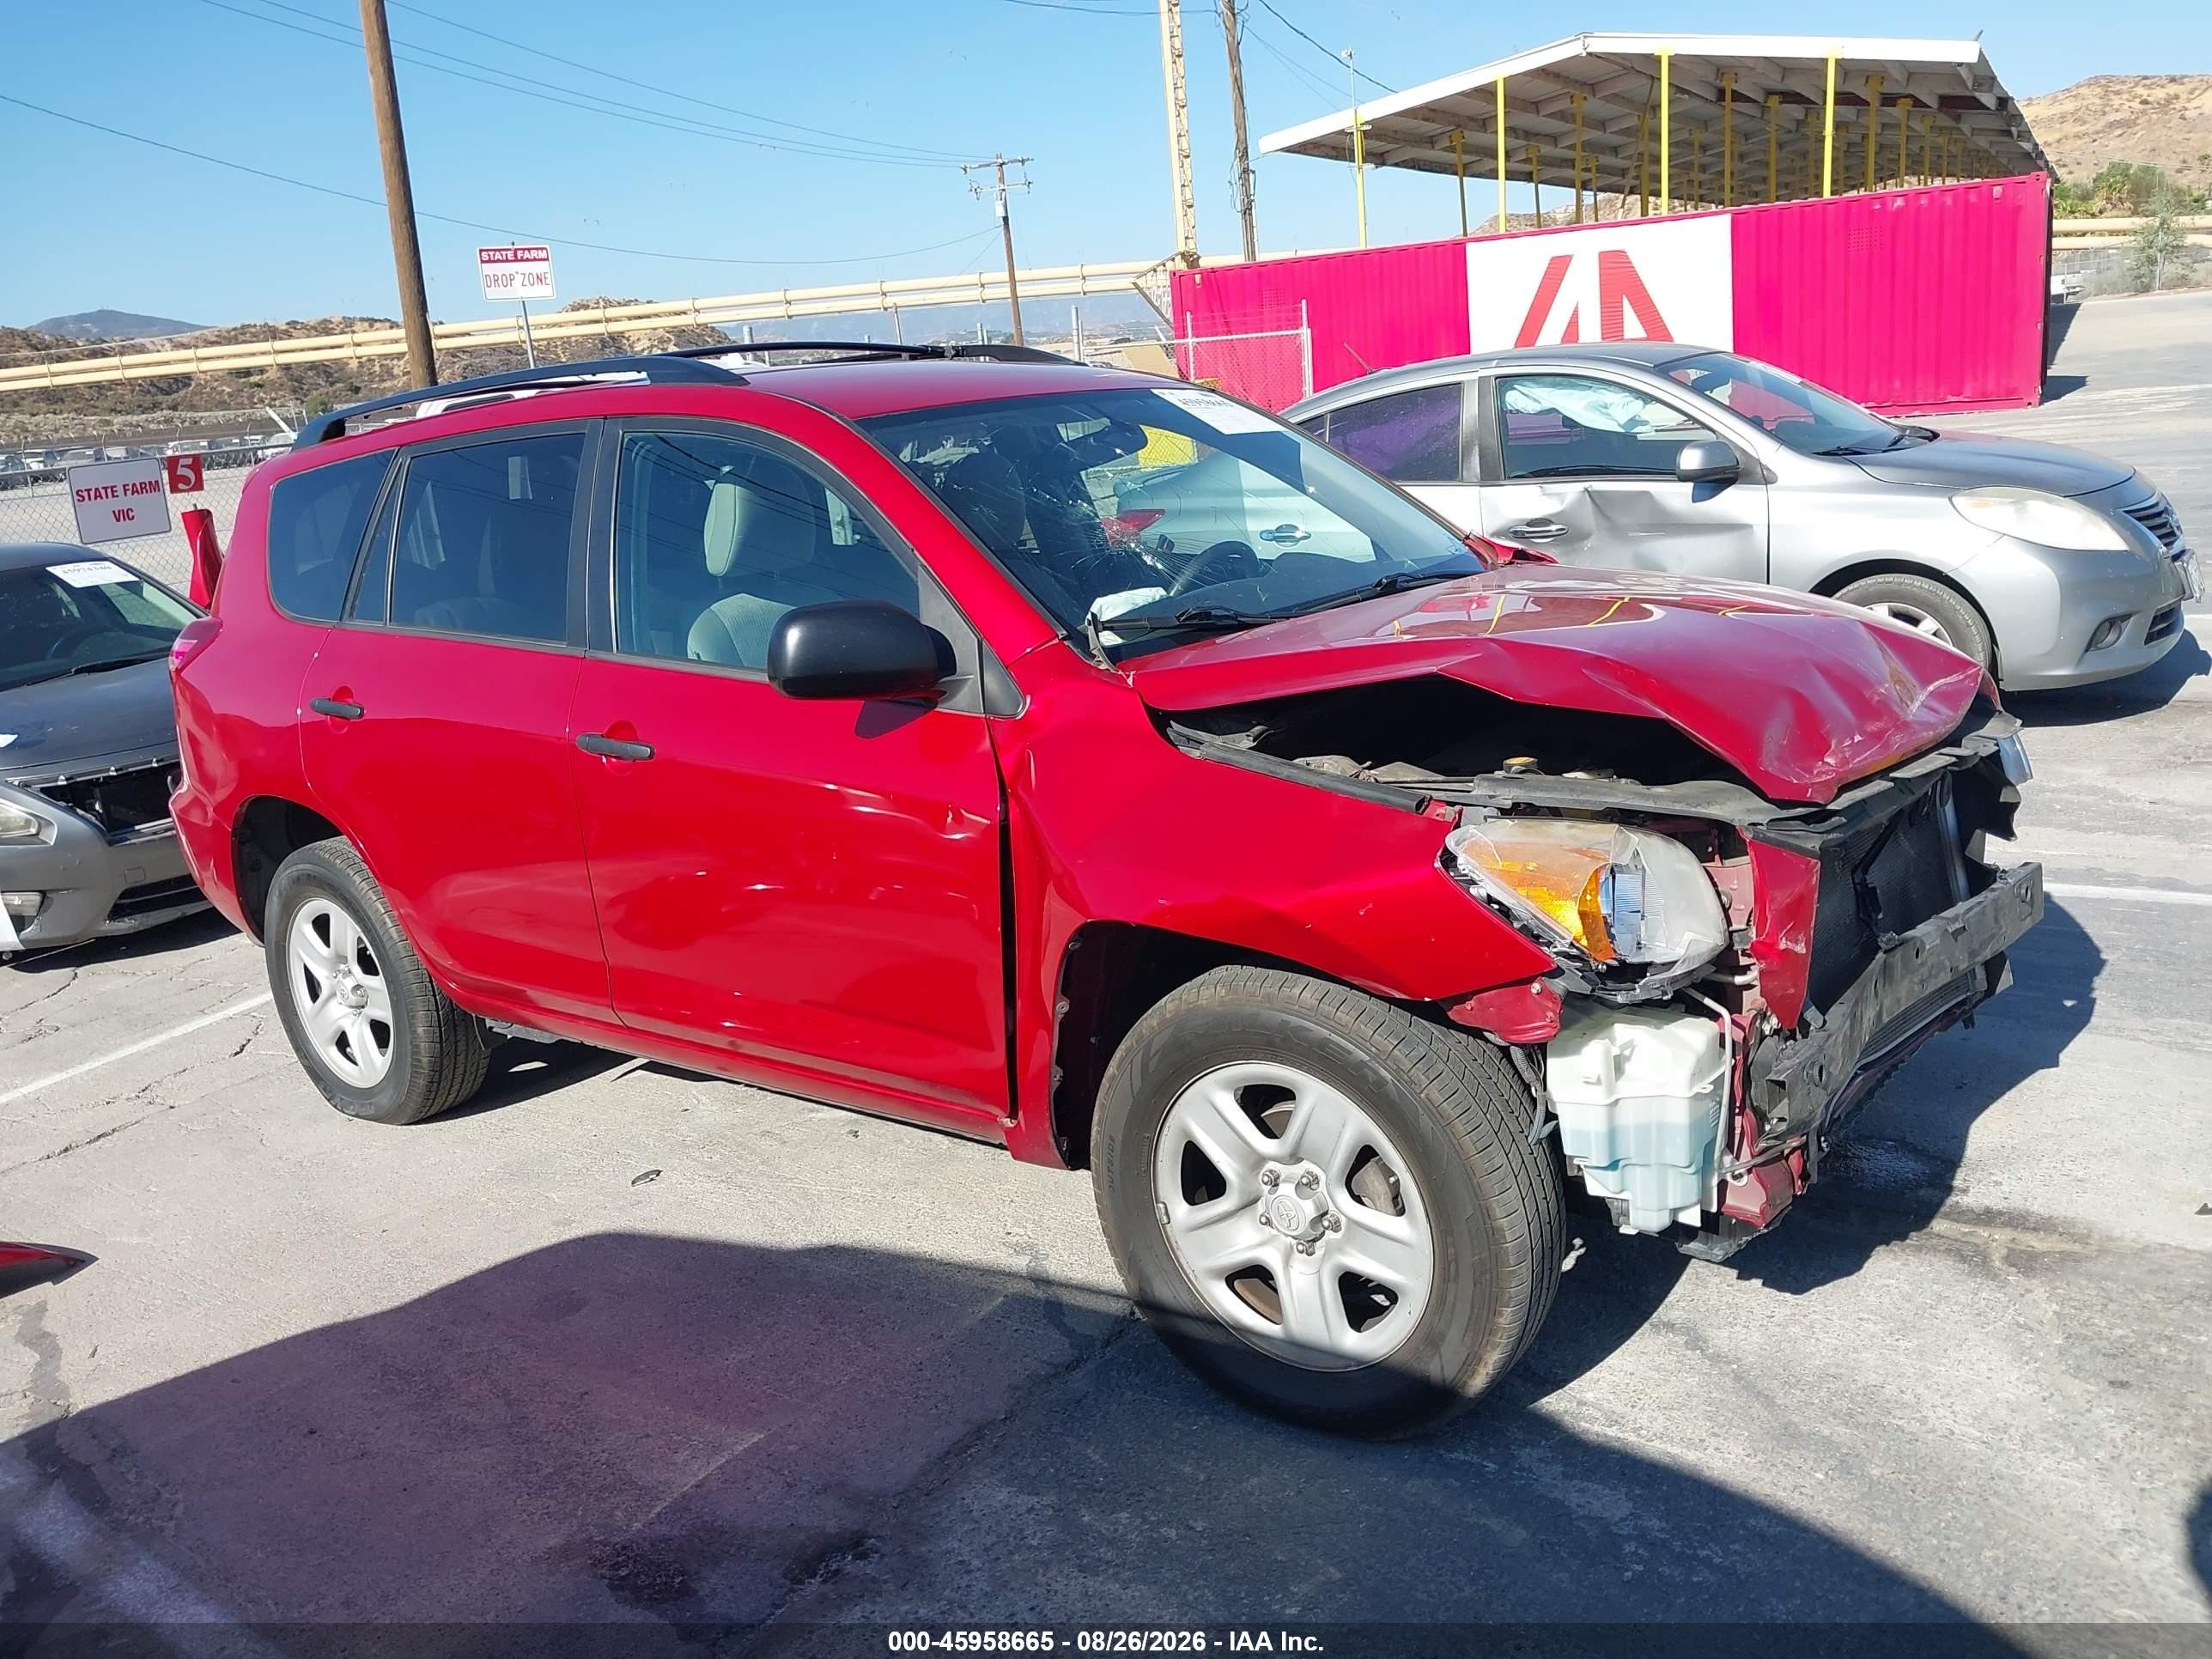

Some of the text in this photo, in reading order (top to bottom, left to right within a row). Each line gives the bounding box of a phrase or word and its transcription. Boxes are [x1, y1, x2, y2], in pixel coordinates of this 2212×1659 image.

[481, 249, 548, 261] STATE FARM
[484, 271, 550, 289] DROP ZONE
[176, 458, 196, 489] 5
[76, 479, 161, 503] STATE FARM
[112, 507, 135, 523] VIC
